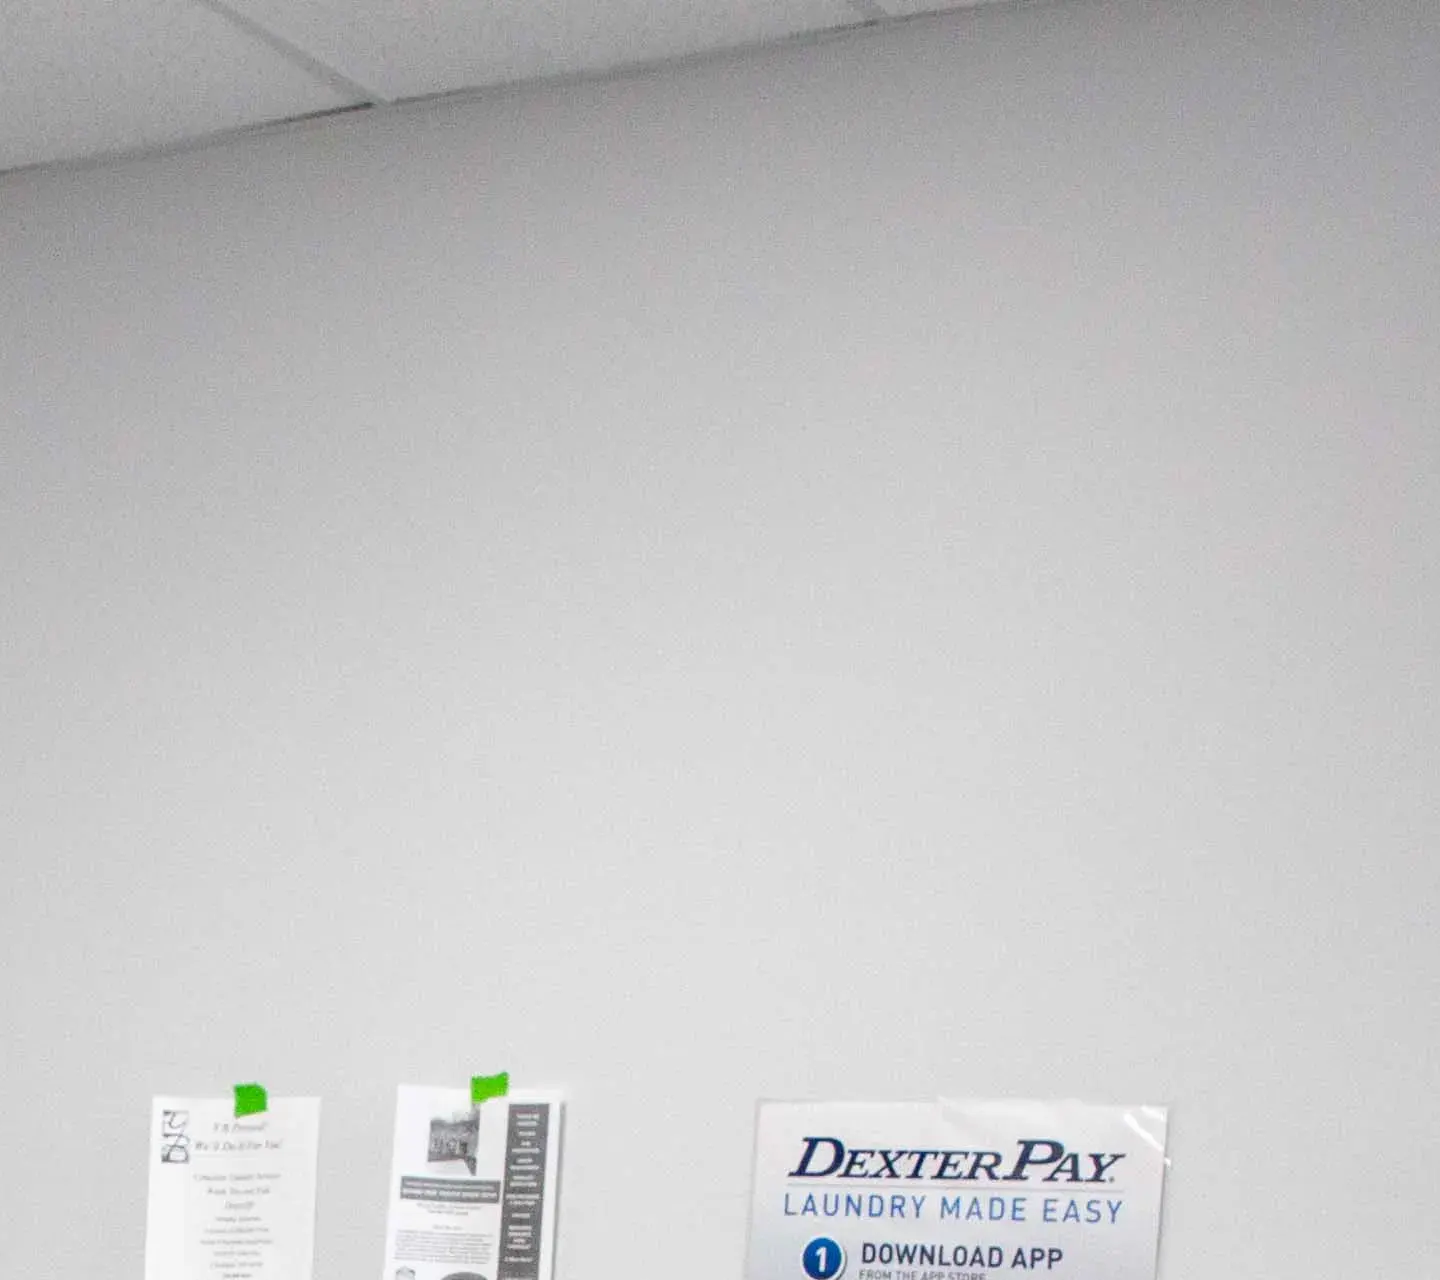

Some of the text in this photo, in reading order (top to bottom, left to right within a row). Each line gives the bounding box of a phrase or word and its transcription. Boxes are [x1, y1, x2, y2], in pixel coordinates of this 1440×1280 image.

[784, 1193, 1122, 1224] LAUNDRY MADE EASY
[862, 1243, 1002, 1268] DOWNLOAD
[1012, 1248, 1063, 1269] APP
